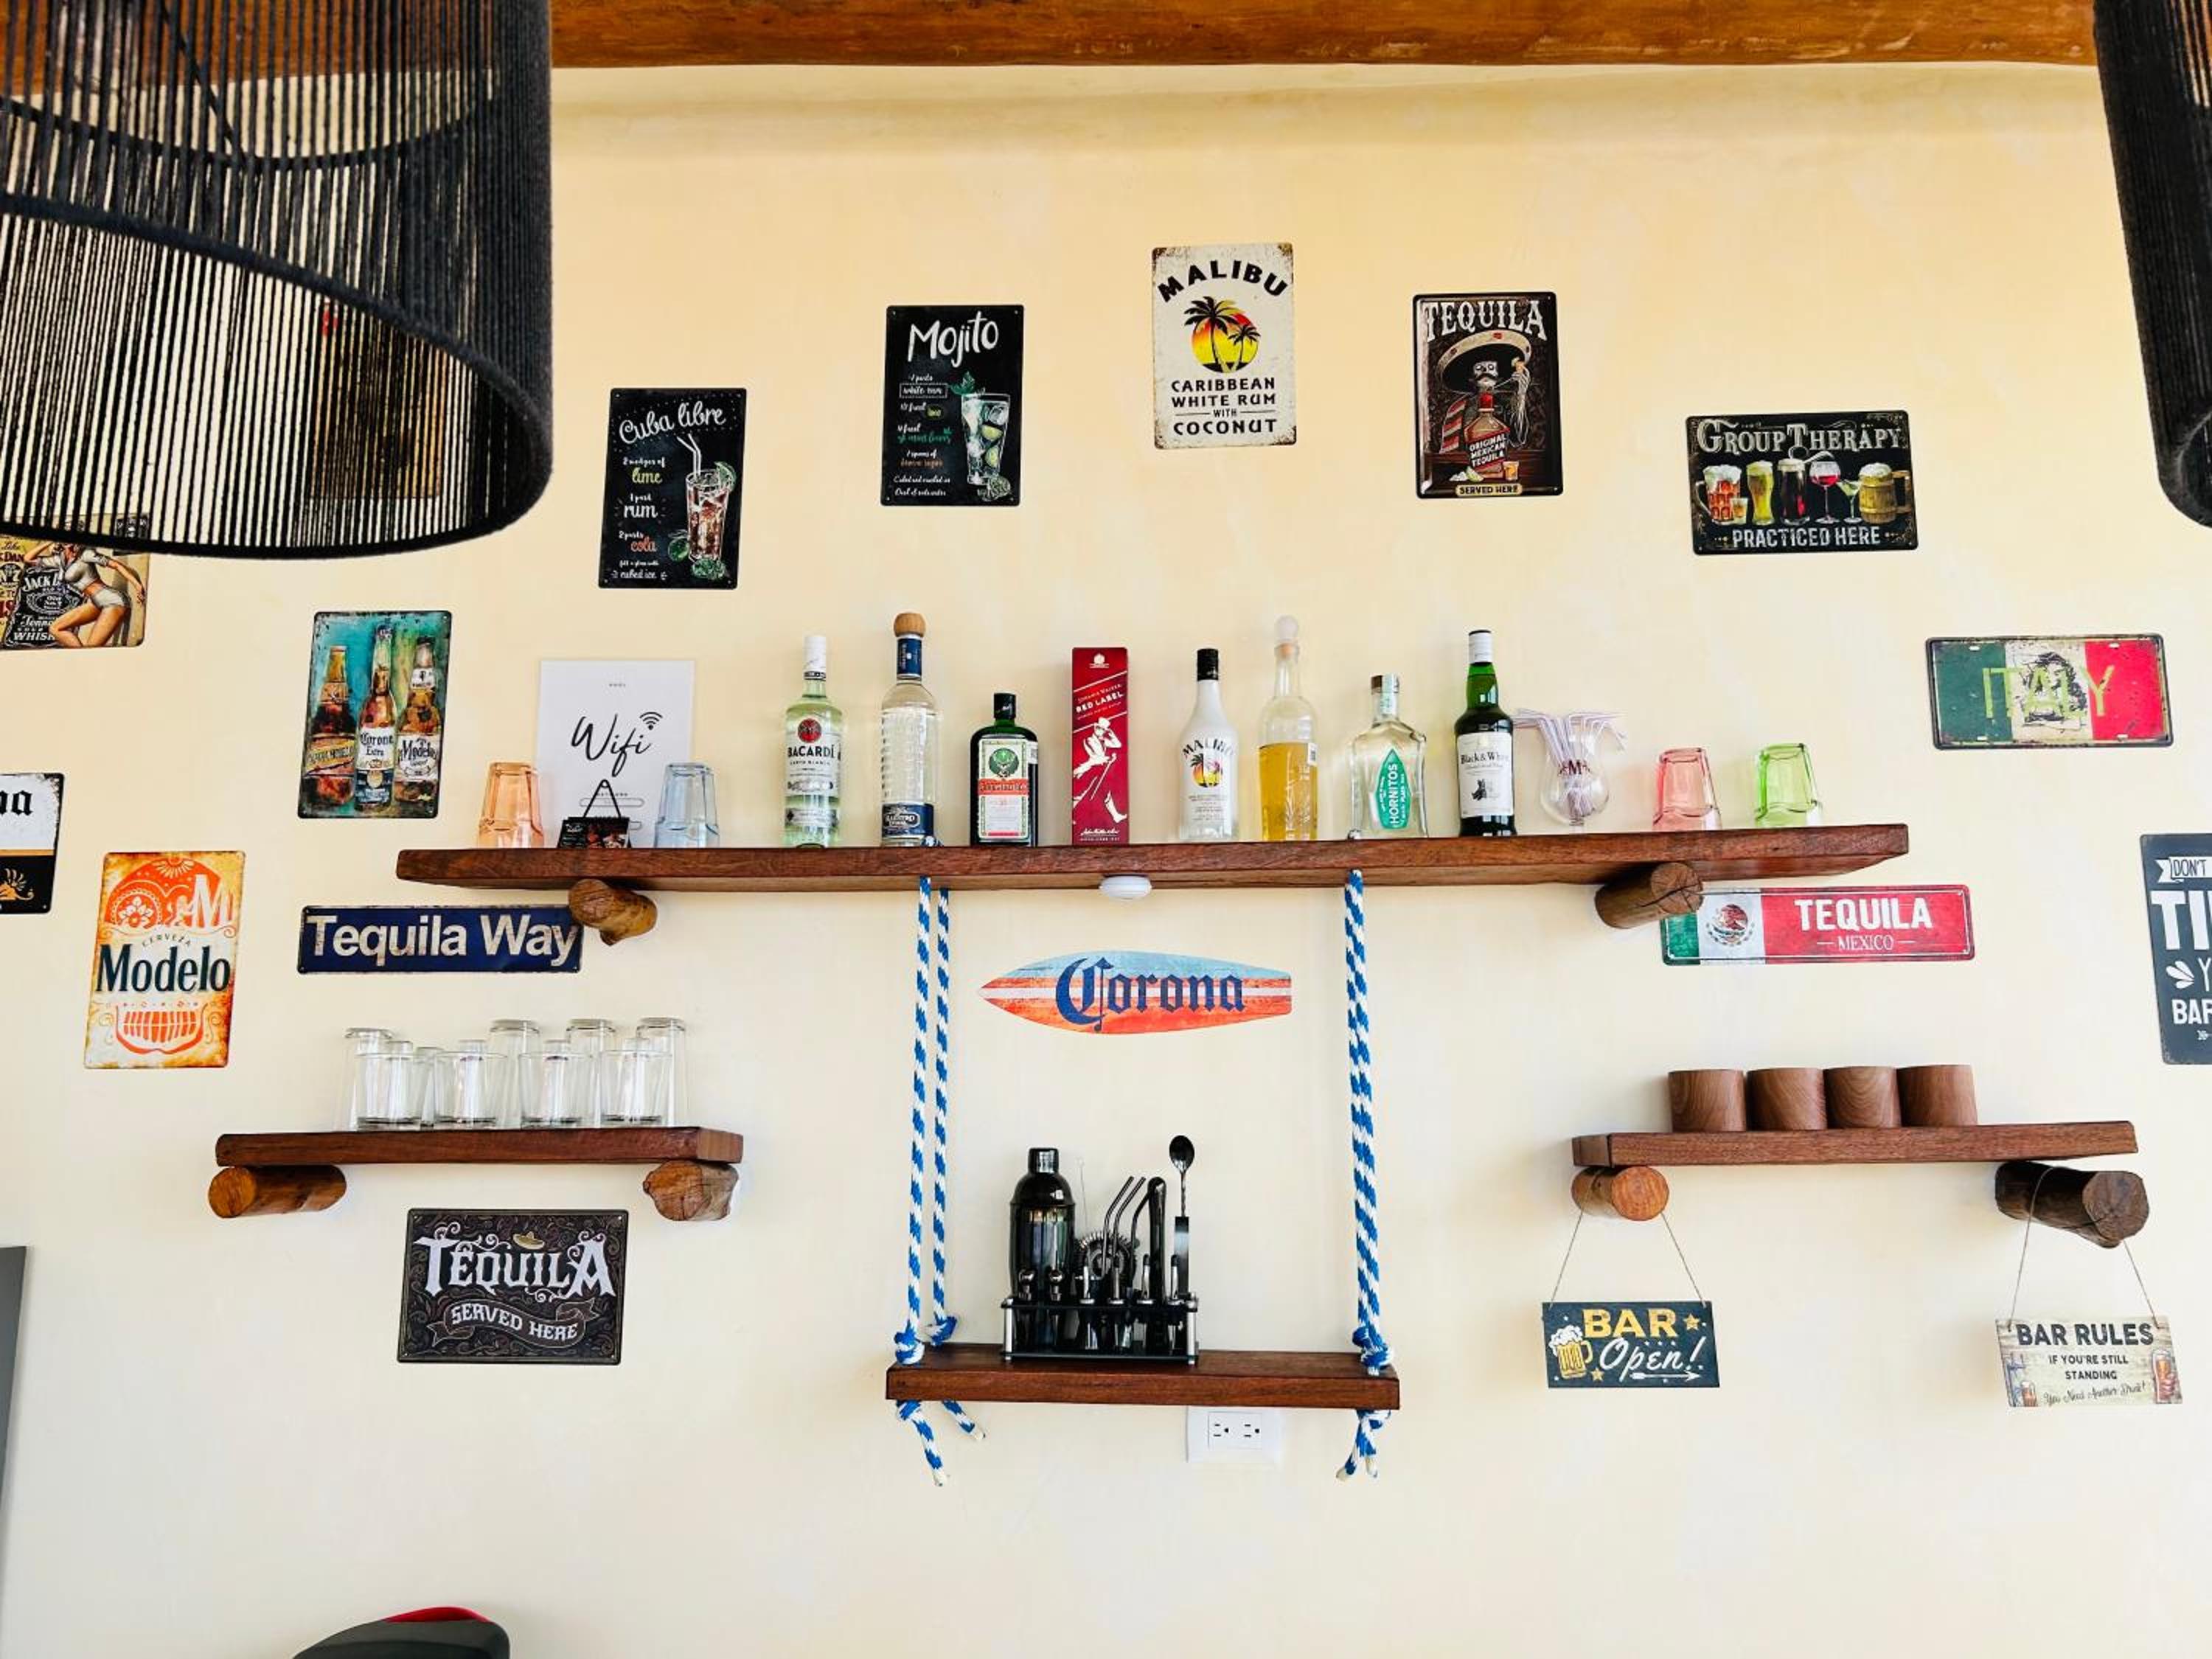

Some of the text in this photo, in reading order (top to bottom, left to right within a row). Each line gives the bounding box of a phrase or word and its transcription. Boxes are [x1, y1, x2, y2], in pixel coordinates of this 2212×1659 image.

[1158, 260, 1287, 302] MALIBU
[1422, 300, 1548, 342] TEQUILA
[908, 310, 998, 368] Mojito
[1171, 378, 1275, 392] CARIBBEAN
[1172, 393, 1276, 407] WHITE RUM
[619, 400, 726, 444] Cuba libre
[1213, 408, 1237, 417] WITH
[1174, 419, 1277, 435] COCONUT
[1469, 433, 1507, 451] ORIGINAL
[1470, 442, 1505, 459] MEXICAN
[1472, 450, 1504, 467] TEQUILA
[632, 467, 663, 484] lime
[1459, 485, 1518, 495] SERVED HERE
[624, 505, 658, 518] rum
[630, 536, 658, 552] cola
[1733, 526, 1880, 548] PRACTICED HERE
[1983, 664, 2114, 718] ITALY
[1076, 701, 1093, 713] RED
[1095, 692, 1124, 706] LABEL
[570, 713, 651, 778] Wifi
[1388, 764, 1399, 824] HORNITOS
[2172, 859, 2207, 877] DON'T
[1794, 898, 1933, 931] TEQUILA
[142, 933, 192, 948] CERVEZA
[306, 914, 578, 966] Tequila Way
[1837, 934, 1894, 950] MEXICO
[95, 943, 231, 992] Modelo
[1056, 956, 1246, 1032] Corona
[413, 1224, 616, 1299] TEQUILA
[451, 1302, 578, 1340] SERVED HERE
[1582, 1309, 1678, 1338] BAR
[2015, 1323, 2154, 1346] BAR RULES
[2049, 1354, 2129, 1365] IF YOU'RE STILL
[2065, 1370, 2118, 1380] STANDING
